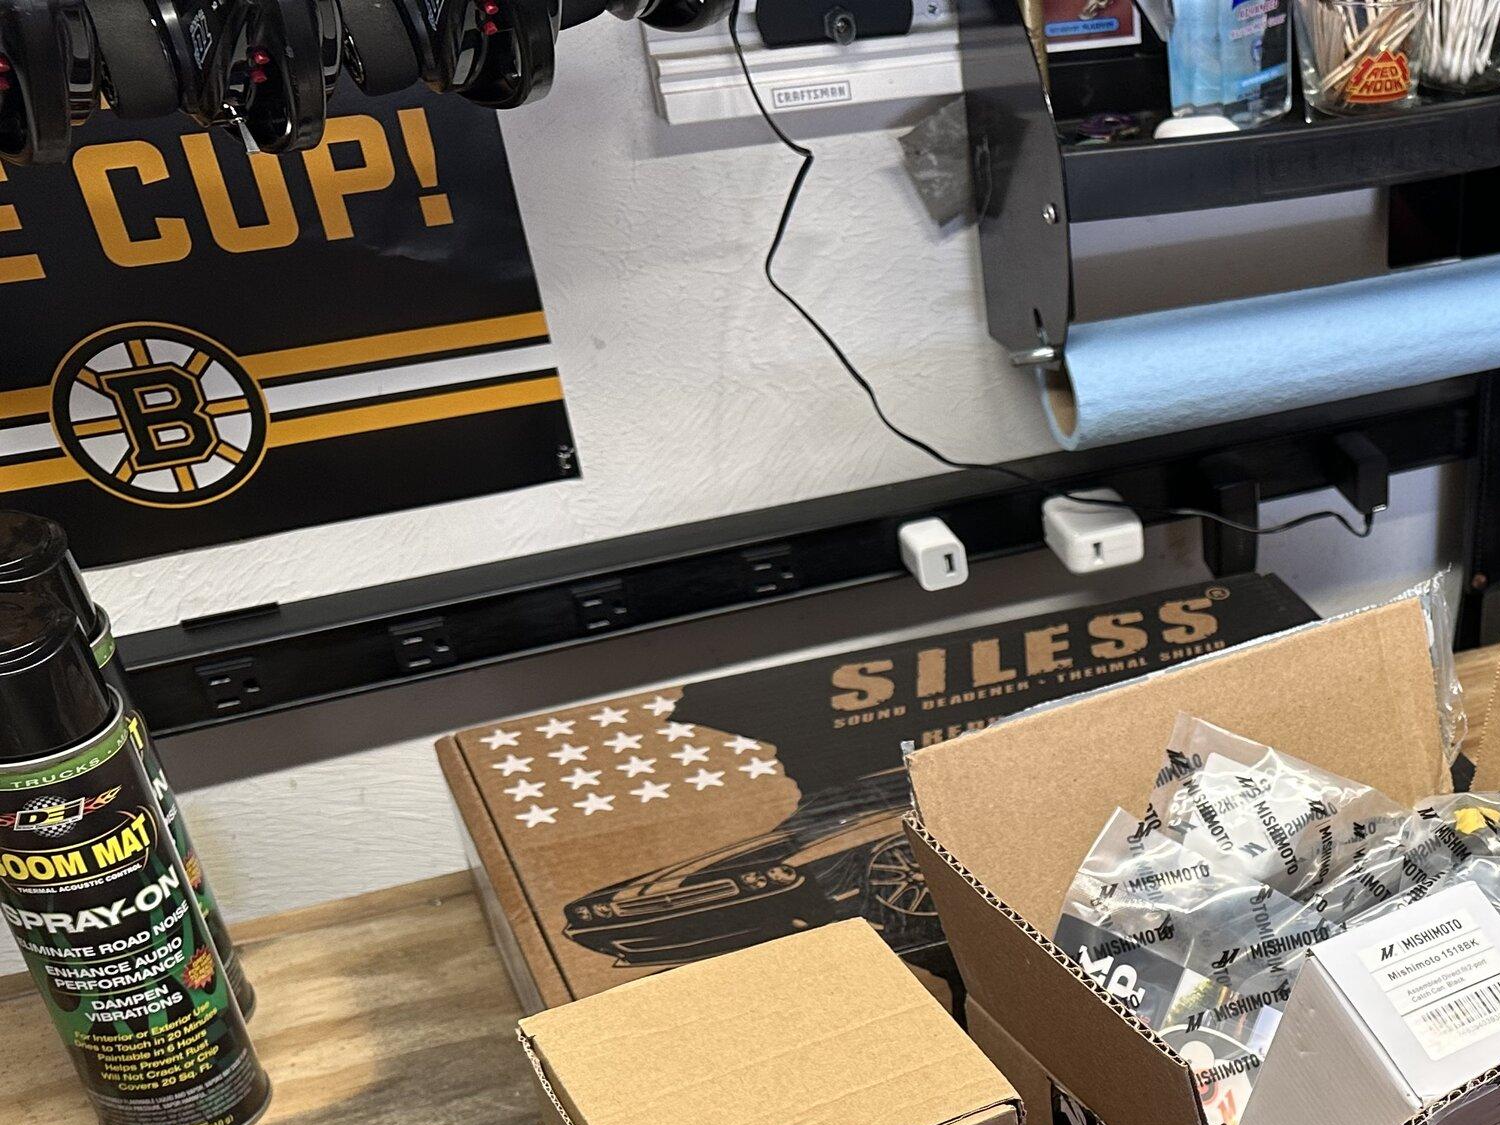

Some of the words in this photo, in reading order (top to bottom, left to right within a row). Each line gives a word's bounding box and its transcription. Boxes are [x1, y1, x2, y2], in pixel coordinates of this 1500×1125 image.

[1358, 80, 1405, 94] HOOK
[1365, 66, 1399, 80] RED
[776, 85, 846, 103] CRAFTSMAN
[73, 107, 453, 267] CUP!
[831, 598, 1219, 711] SILESS
[833, 706, 907, 729] SOUND
[922, 680, 1030, 711] DEADENER
[1056, 657, 1148, 684] THERMAL
[1159, 639, 1227, 663] SHIELD
[10, 757, 101, 789] TRUCKS
[0, 850, 88, 882] OOM
[91, 812, 151, 869] MAT
[17, 885, 57, 894] THERMAL
[58, 877, 105, 893] ACOUSTIC
[105, 863, 143, 882] CONTROL
[1128, 863, 1211, 894] MISHIMOTO
[1, 864, 181, 934] SPRAY-ON
[18, 937, 97, 958] ELIMINATE
[98, 928, 151, 956] ROAD
[153, 899, 190, 936] NOISE
[1250, 925, 1331, 960] MISHIMOTO
[1401, 918, 1463, 951] MISHIMOTO
[45, 960, 132, 979] ENHANCE
[134, 936, 183, 969] AUDIO
[55, 950, 186, 991] PERFORMANCE
[1387, 954, 1441, 982] Mishimoto
[1441, 938, 1480, 960] 1518BK
[91, 984, 170, 1011] DAMPEN
[1406, 977, 1443, 997] Assembled
[1442, 968, 1462, 985] Direct
[1411, 990, 1431, 1004] Catch
[1446, 976, 1466, 989] Black
[85, 990, 184, 1023] VIBRATIONS
[1213, 985, 1292, 1023] MISHIMOTO
[74, 1039, 100, 1052] Dries
[101, 1043, 114, 1053] to
[115, 1040, 151, 1053] Touch
[166, 1030, 182, 1043] 20
[183, 1007, 218, 1035] Minutes
[92, 1032, 134, 1043] Interior
[151, 1013, 192, 1036] Exterior
[192, 1001, 210, 1017] Use
[97, 1050, 151, 1063] Paintable
[176, 1029, 207, 1050] Hours
[101, 1071, 121, 1082] Will
[123, 1070, 144, 1082] Not
[146, 1066, 182, 1080] Crack
[196, 1044, 219, 1065] Chip
[104, 1060, 138, 1073] Helps
[140, 1052, 184, 1070] Prevent
[185, 1039, 209, 1056] Rust
[118, 1080, 159, 1091] Covers
[161, 1076, 177, 1087] 20
[1196, 1053, 1261, 1088] ISHIMOTO
